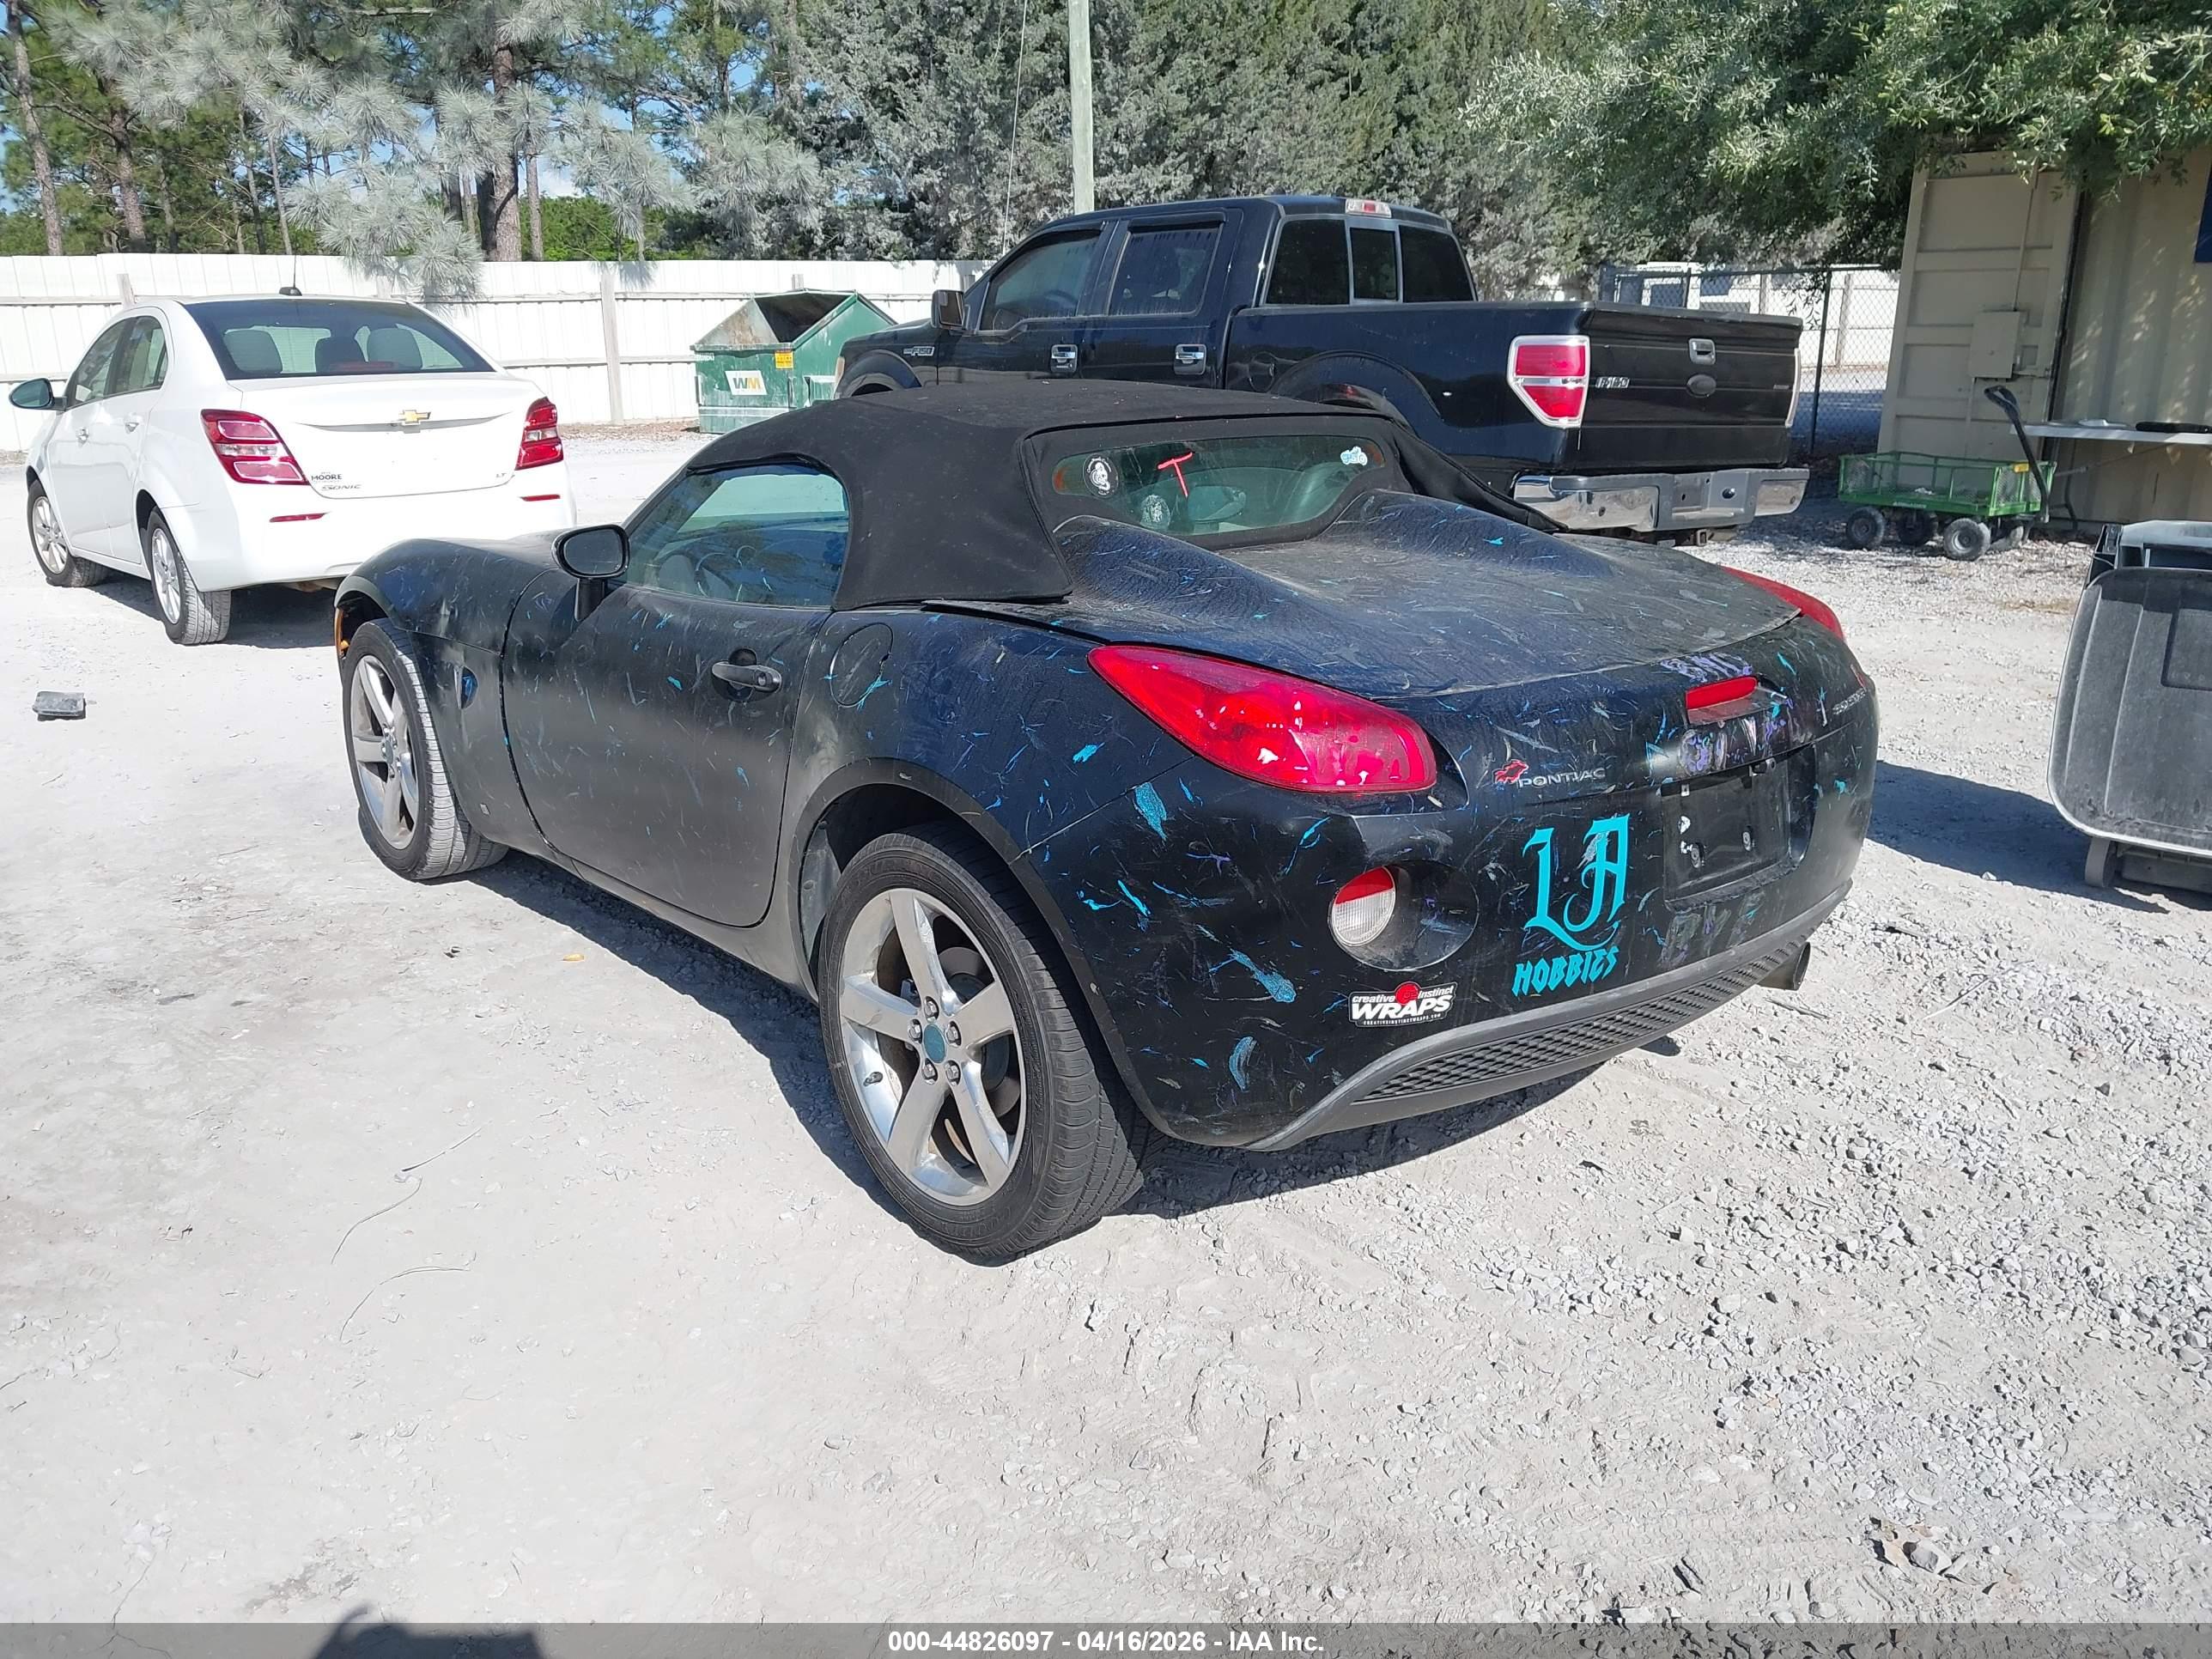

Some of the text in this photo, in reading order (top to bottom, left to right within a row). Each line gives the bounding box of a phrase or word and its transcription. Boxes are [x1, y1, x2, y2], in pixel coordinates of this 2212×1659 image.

[732, 377, 762, 389] WM
[1518, 767, 1607, 788] PONTIAC
[1522, 813, 1630, 951] LA
[1511, 945, 1620, 997] HOBBIES
[1352, 994, 1396, 1003] creative
[1352, 994, 1453, 1020] WRAPS
